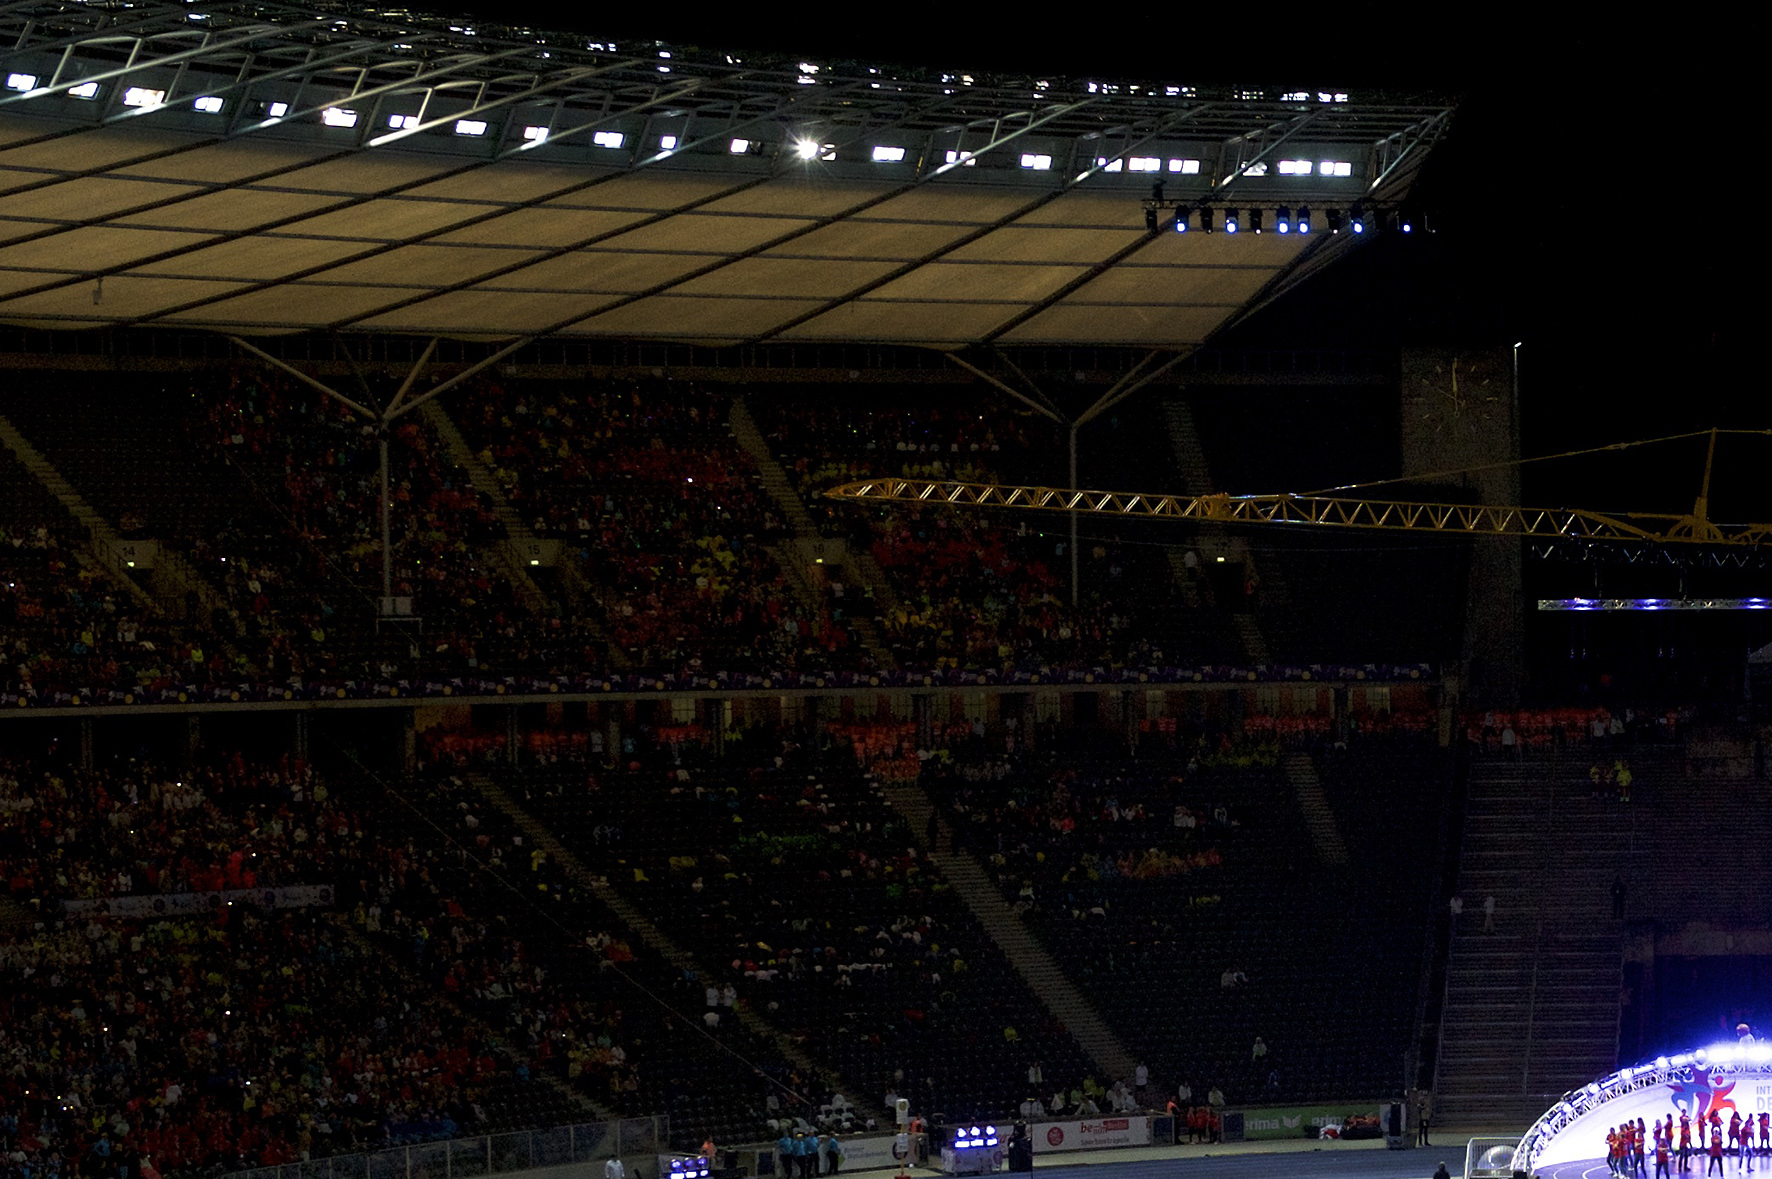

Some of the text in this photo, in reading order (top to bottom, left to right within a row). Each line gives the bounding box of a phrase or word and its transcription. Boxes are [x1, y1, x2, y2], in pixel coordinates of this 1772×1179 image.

[528, 545, 540, 555] 15
[1311, 1115, 1342, 1126] erim
[1080, 1122, 1093, 1133] be
